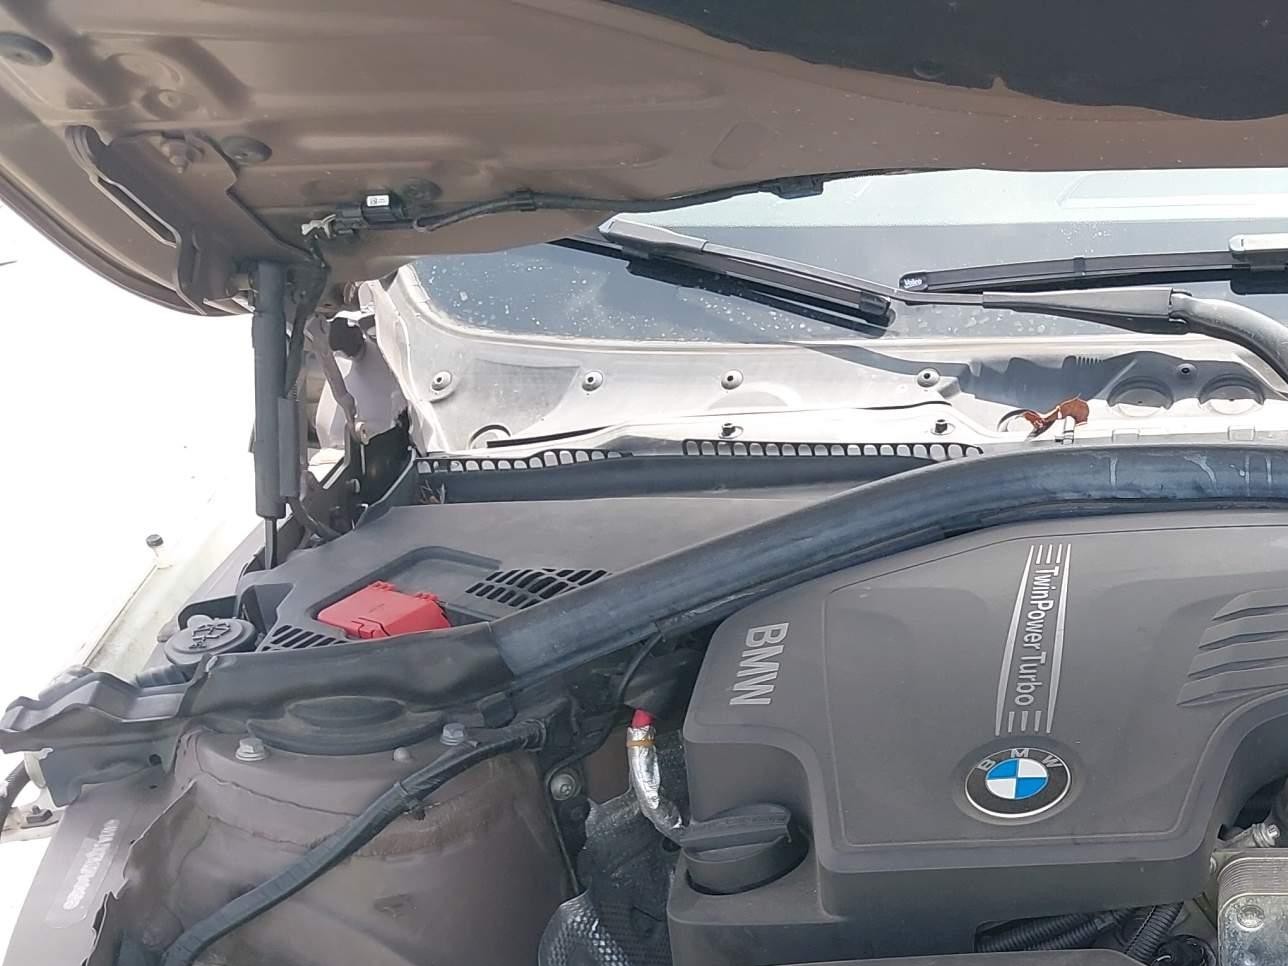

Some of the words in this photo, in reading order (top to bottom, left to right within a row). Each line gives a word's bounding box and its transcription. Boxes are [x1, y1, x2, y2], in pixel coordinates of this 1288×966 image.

[1023, 566, 1060, 650] TwinPower
[729, 622, 790, 705] BMW
[1014, 651, 1047, 706] Turbo
[976, 747, 1064, 772] BMW
